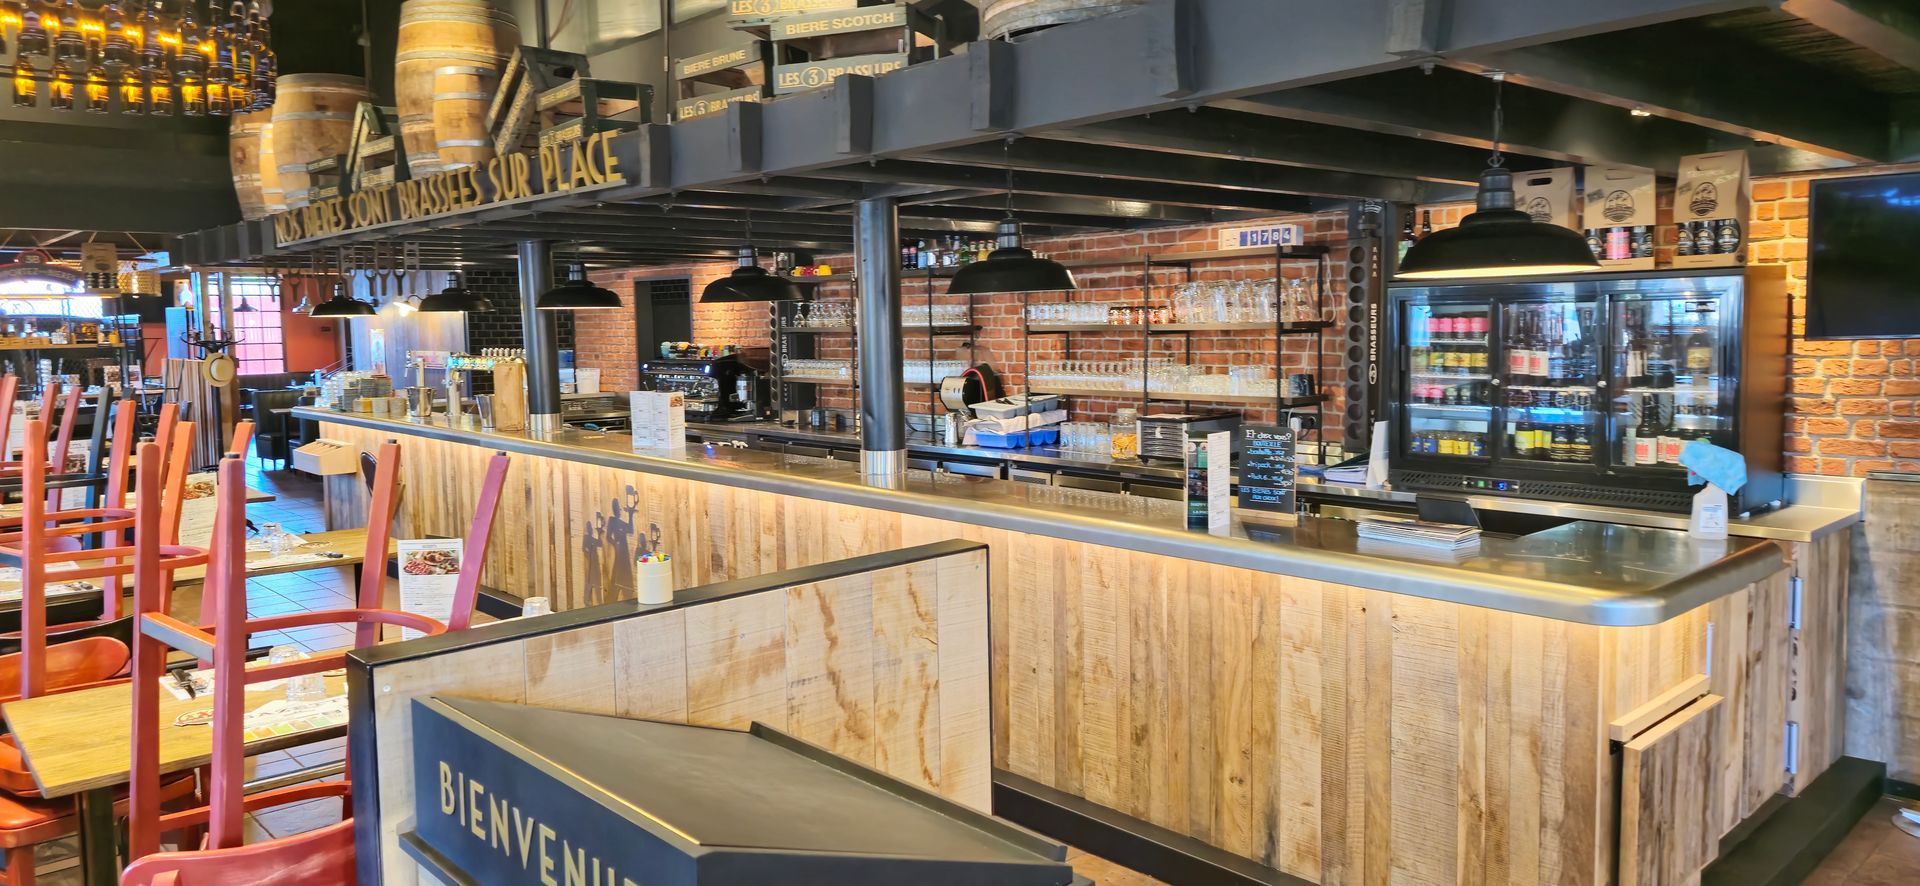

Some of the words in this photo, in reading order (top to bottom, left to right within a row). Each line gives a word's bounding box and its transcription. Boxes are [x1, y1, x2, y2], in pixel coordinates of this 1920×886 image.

[785, 21, 829, 35] BIERE
[832, 12, 895, 30] SCOTCH
[683, 60, 711, 75] BIERE
[712, 50, 746, 67] BRUNE
[779, 72, 800, 86] LES
[680, 105, 694, 119] LES
[274, 208, 300, 243] NOS
[348, 187, 392, 229] SONT
[489, 152, 532, 202] SUR
[540, 128, 623, 194] PLACE
[1369, 303, 1378, 362] BRASSEURS
[439, 760, 640, 886] BIENVEN
